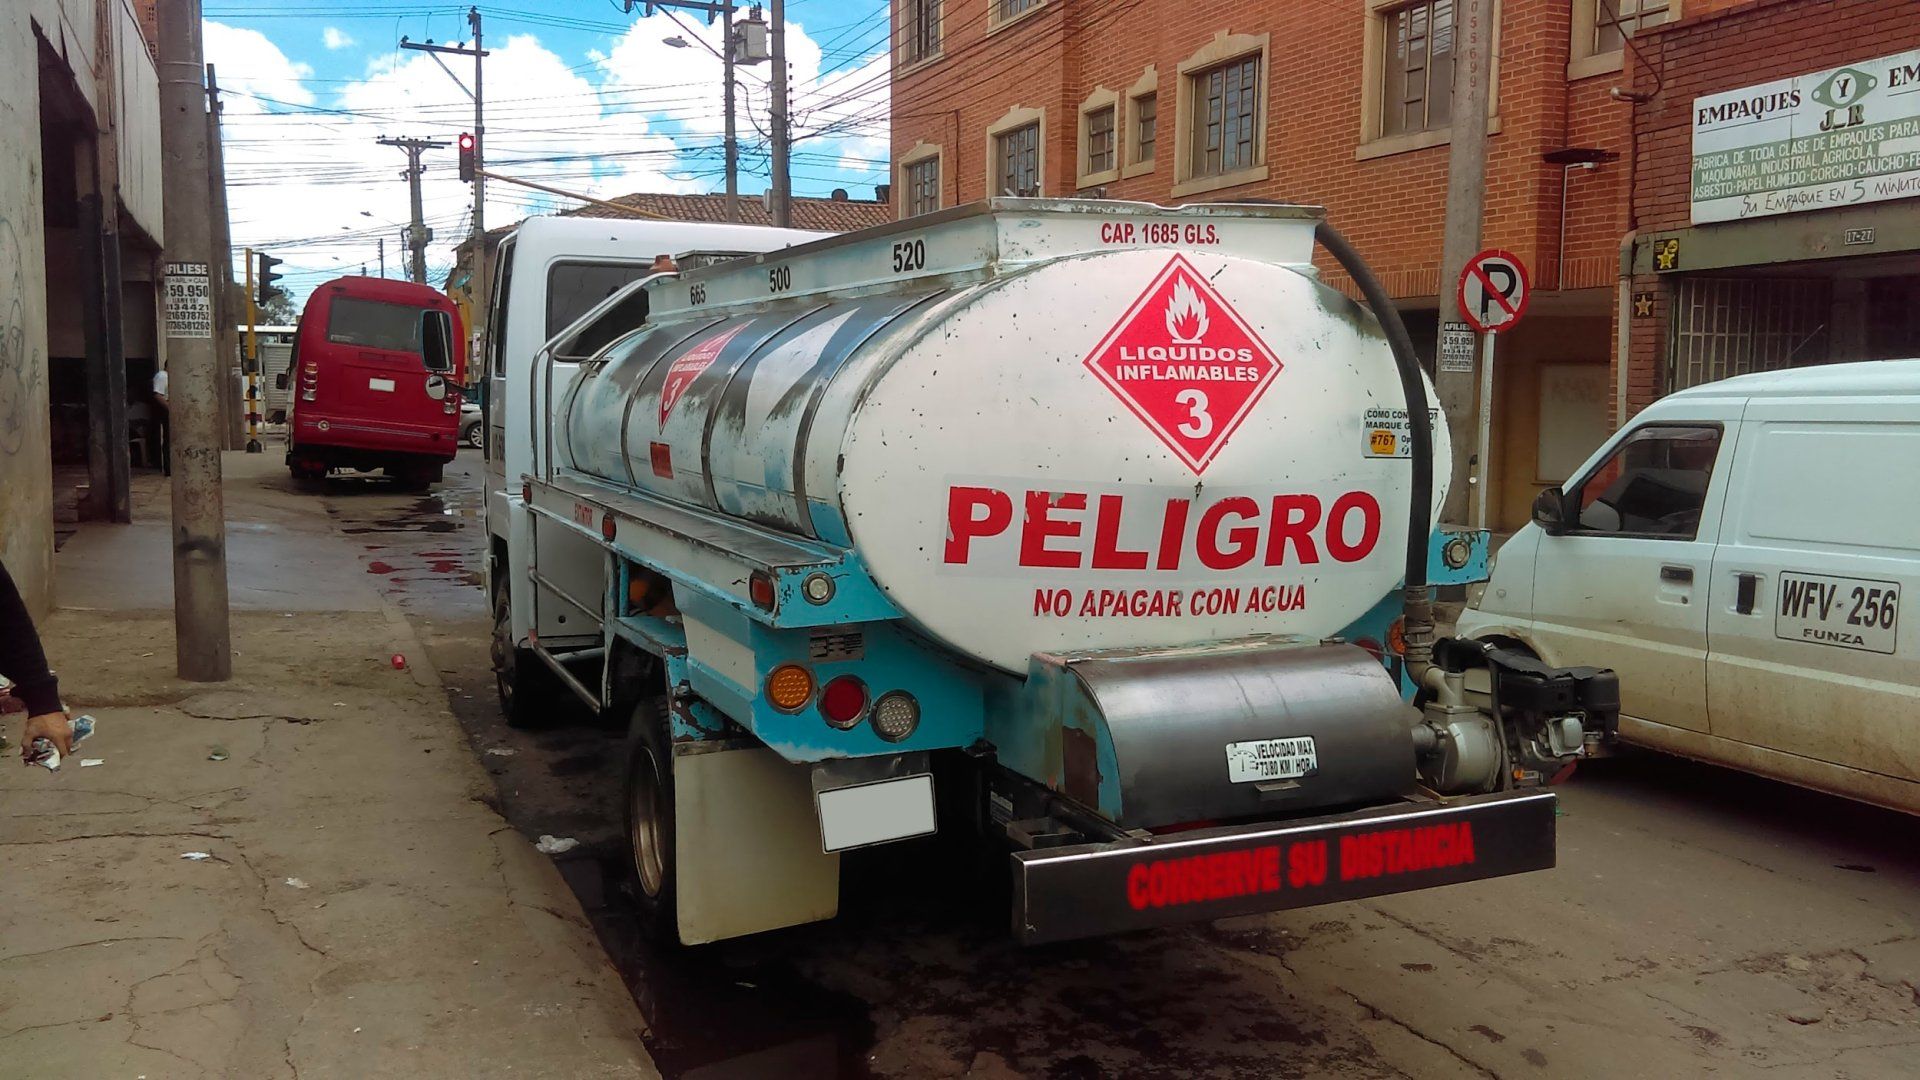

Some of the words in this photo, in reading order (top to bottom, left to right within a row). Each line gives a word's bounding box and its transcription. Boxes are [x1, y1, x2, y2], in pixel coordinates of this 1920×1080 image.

[1836, 78, 1851, 98] Y
[1697, 89, 1801, 126] EMPAQUES
[1694, 154, 1729, 170] FABRICA
[1733, 150, 1746, 164] DE
[1749, 145, 1775, 162] TODA
[1779, 138, 1810, 156] CLASE
[1813, 137, 1826, 151] DE
[1830, 126, 1885, 149] EMPAQUES
[1889, 120, 1920, 138] PARA
[1701, 163, 1757, 183] MAQUINARIA
[1830, 185, 1846, 201] EN
[1849, 180, 1866, 202] 5
[1102, 222, 1136, 244] CAP.
[1141, 223, 1179, 244] 1685
[1184, 224, 1220, 245] GLS.
[1847, 230, 1872, 242] 17-27
[893, 239, 925, 273] 520
[769, 265, 791, 293] 500
[690, 283, 706, 306] 665
[1120, 346, 1253, 362] LIQUIDOS
[1116, 365, 1259, 382] INFLAMABLES
[1175, 388, 1213, 439] 3
[1365, 421, 1402, 430] MARQUE
[1370, 434, 1396, 446] #767
[943, 486, 1382, 570] PELIGRO
[1033, 588, 1072, 617] NO
[1079, 589, 1183, 618] APAGAR
[1189, 589, 1238, 616] CON
[1244, 584, 1306, 613] AGUA
[1782, 579, 1837, 621] WFV
[1846, 586, 1897, 630] 256
[1803, 628, 1865, 645] FUNZA
[1255, 741, 1296, 759] VELOCIDAD
[1296, 739, 1314, 755] MAX
[1279, 759, 1291, 774] KM
[1127, 846, 1282, 910] CONSERVE
[1288, 840, 1328, 888] SU
[1340, 821, 1475, 881] DISTANCIA
